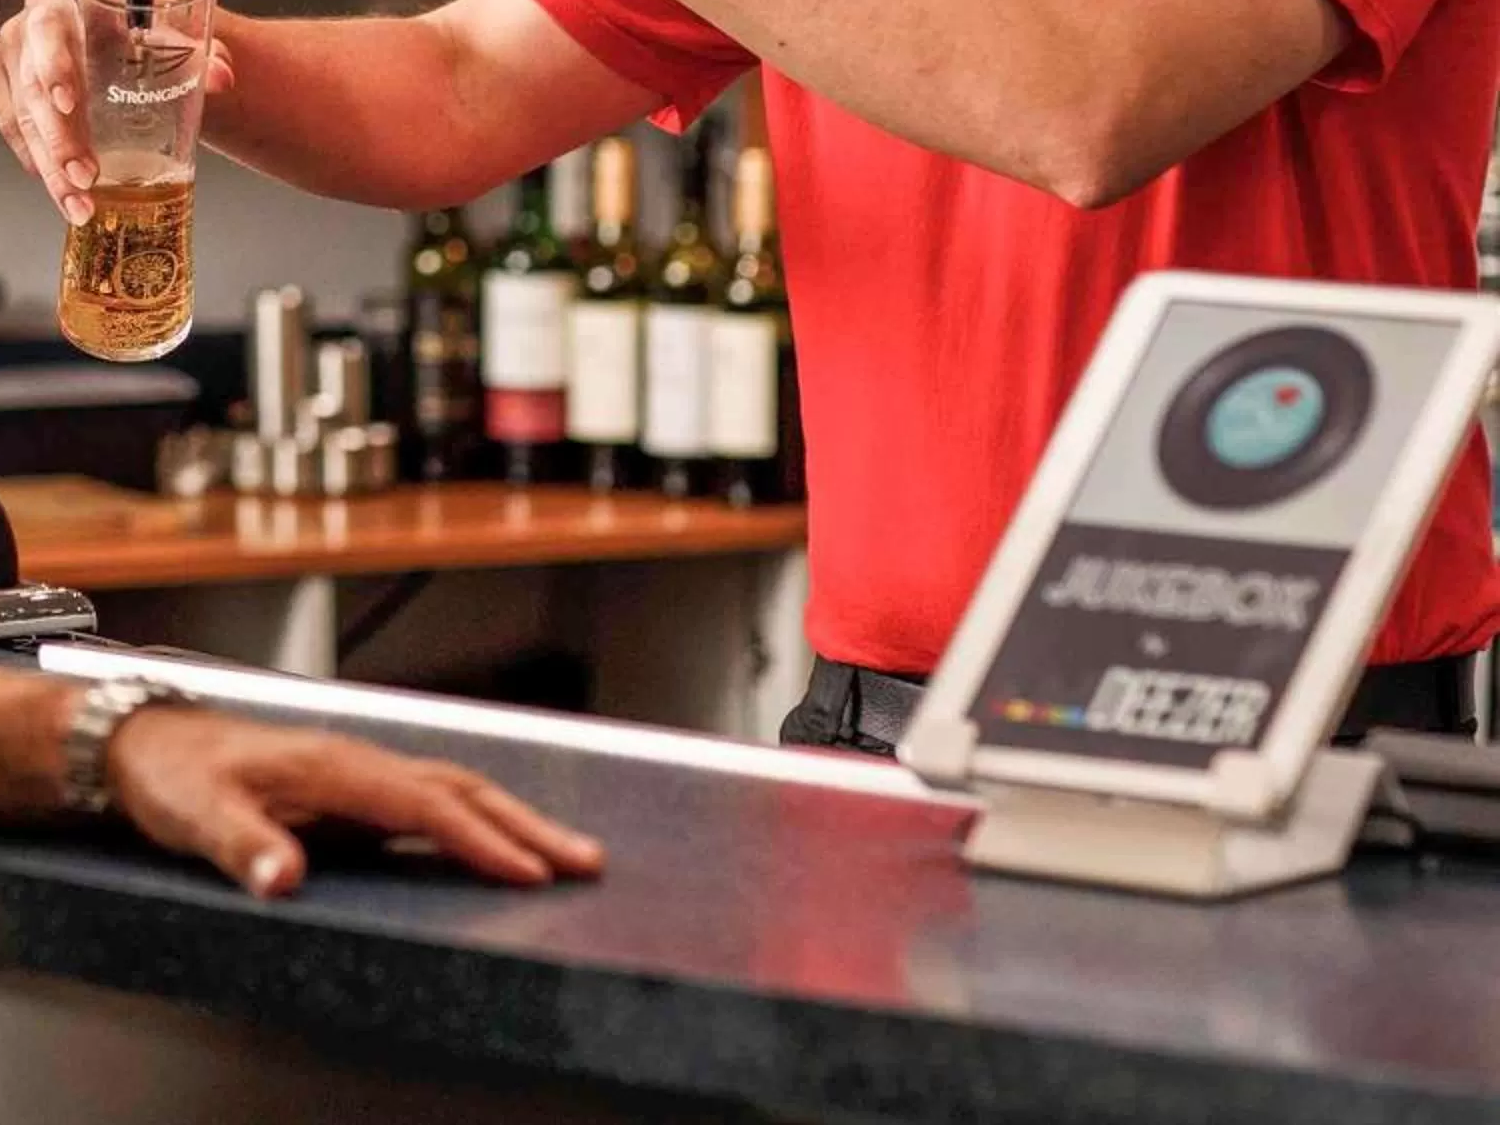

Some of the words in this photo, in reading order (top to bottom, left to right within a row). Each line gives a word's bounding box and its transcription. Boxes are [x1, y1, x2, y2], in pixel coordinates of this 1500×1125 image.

[107, 73, 200, 104] STRONGBOW
[1042, 554, 1322, 631] JUKEBOX
[1084, 666, 1274, 745] DEEZER
